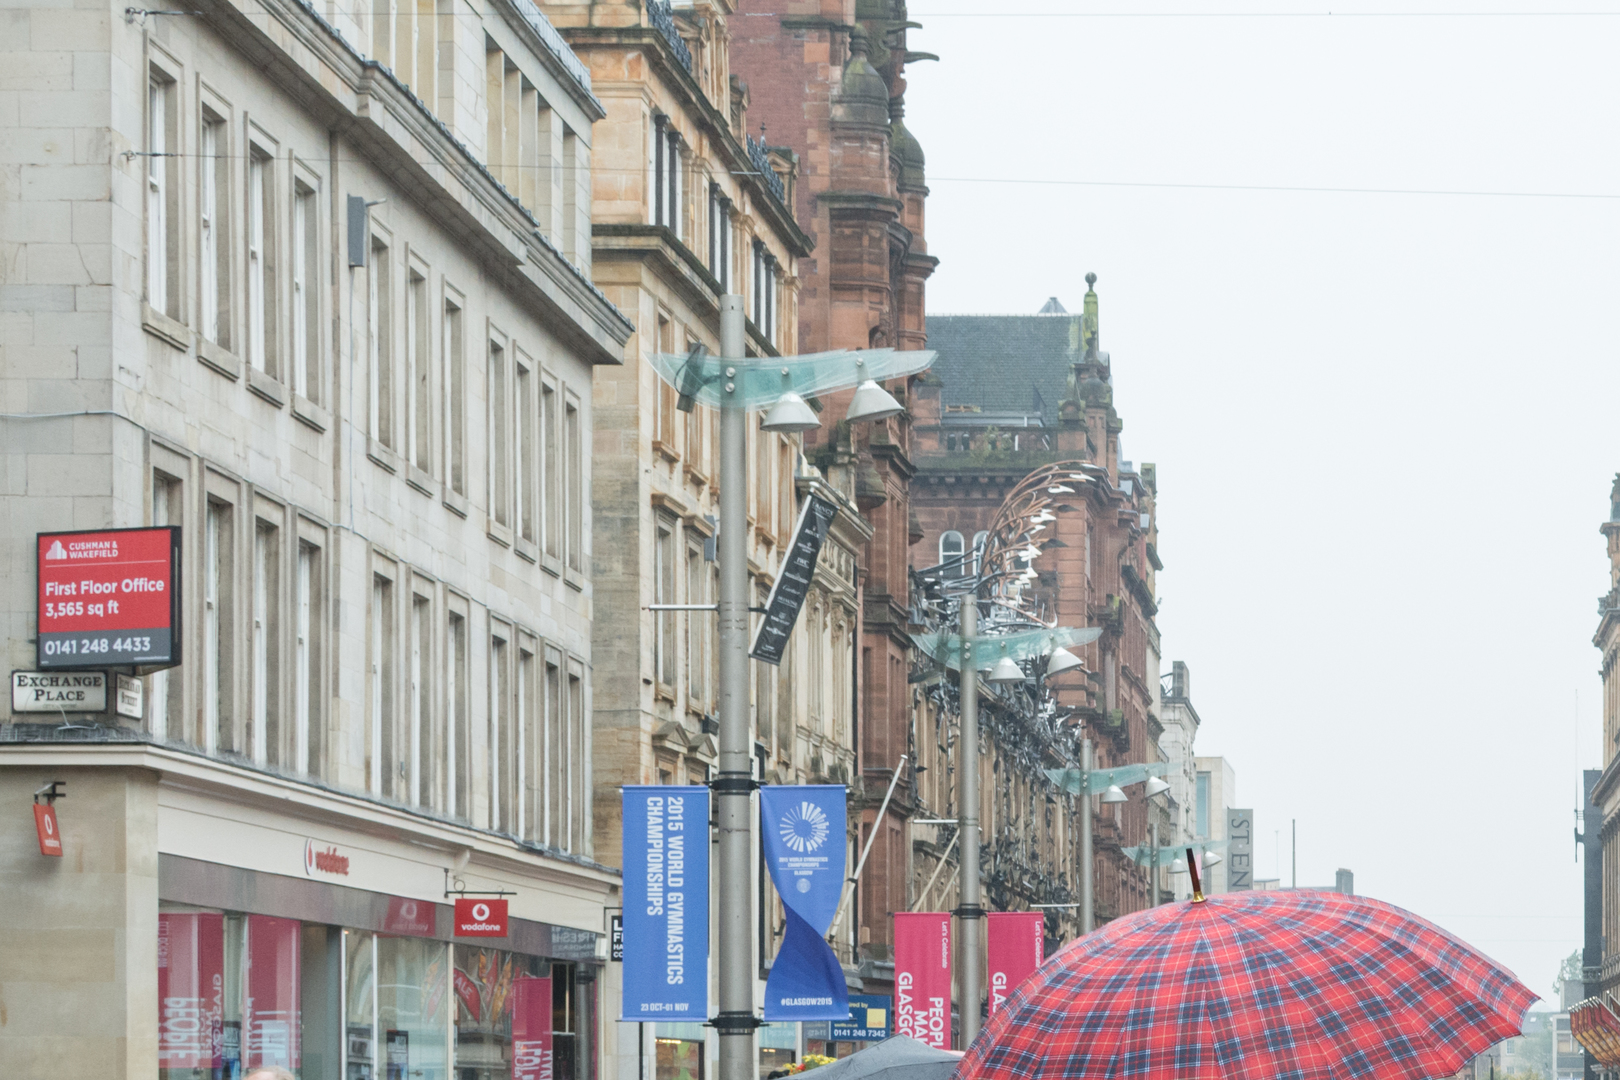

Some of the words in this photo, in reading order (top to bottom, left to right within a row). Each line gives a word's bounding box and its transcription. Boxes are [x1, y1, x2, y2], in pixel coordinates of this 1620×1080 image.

[69, 542, 110, 550] CUSHMAN
[112, 541, 118, 549] &
[69, 550, 118, 559] WAKEFIELD
[46, 582, 76, 596] First
[81, 580, 117, 595] Floor
[121, 578, 164, 593] Office
[46, 602, 84, 619] 3,565
[87, 603, 103, 617] sq
[107, 600, 118, 614] ft
[45, 640, 77, 655] 0141
[81, 638, 109, 653] 248
[113, 636, 151, 651] 4433
[17, 675, 102, 687] EXCHANGE
[34, 689, 85, 701] PLACE
[667, 796, 684, 832] 2015
[647, 796, 664, 916] CHAMPIONSHIPS
[667, 835, 684, 888] WORLD
[461, 923, 501, 931] vodafone
[667, 893, 684, 985] GYMNASTICS
[641, 1003, 649, 1012] 23
[674, 1003, 689, 1012] NOV
[781, 997, 832, 1006] #GLASGOW2015
[898, 972, 913, 1040] GLASGO
[834, 1029, 851, 1037] 0141
[853, 1029, 866, 1037] 248
[868, 1029, 885, 1037] 7342
